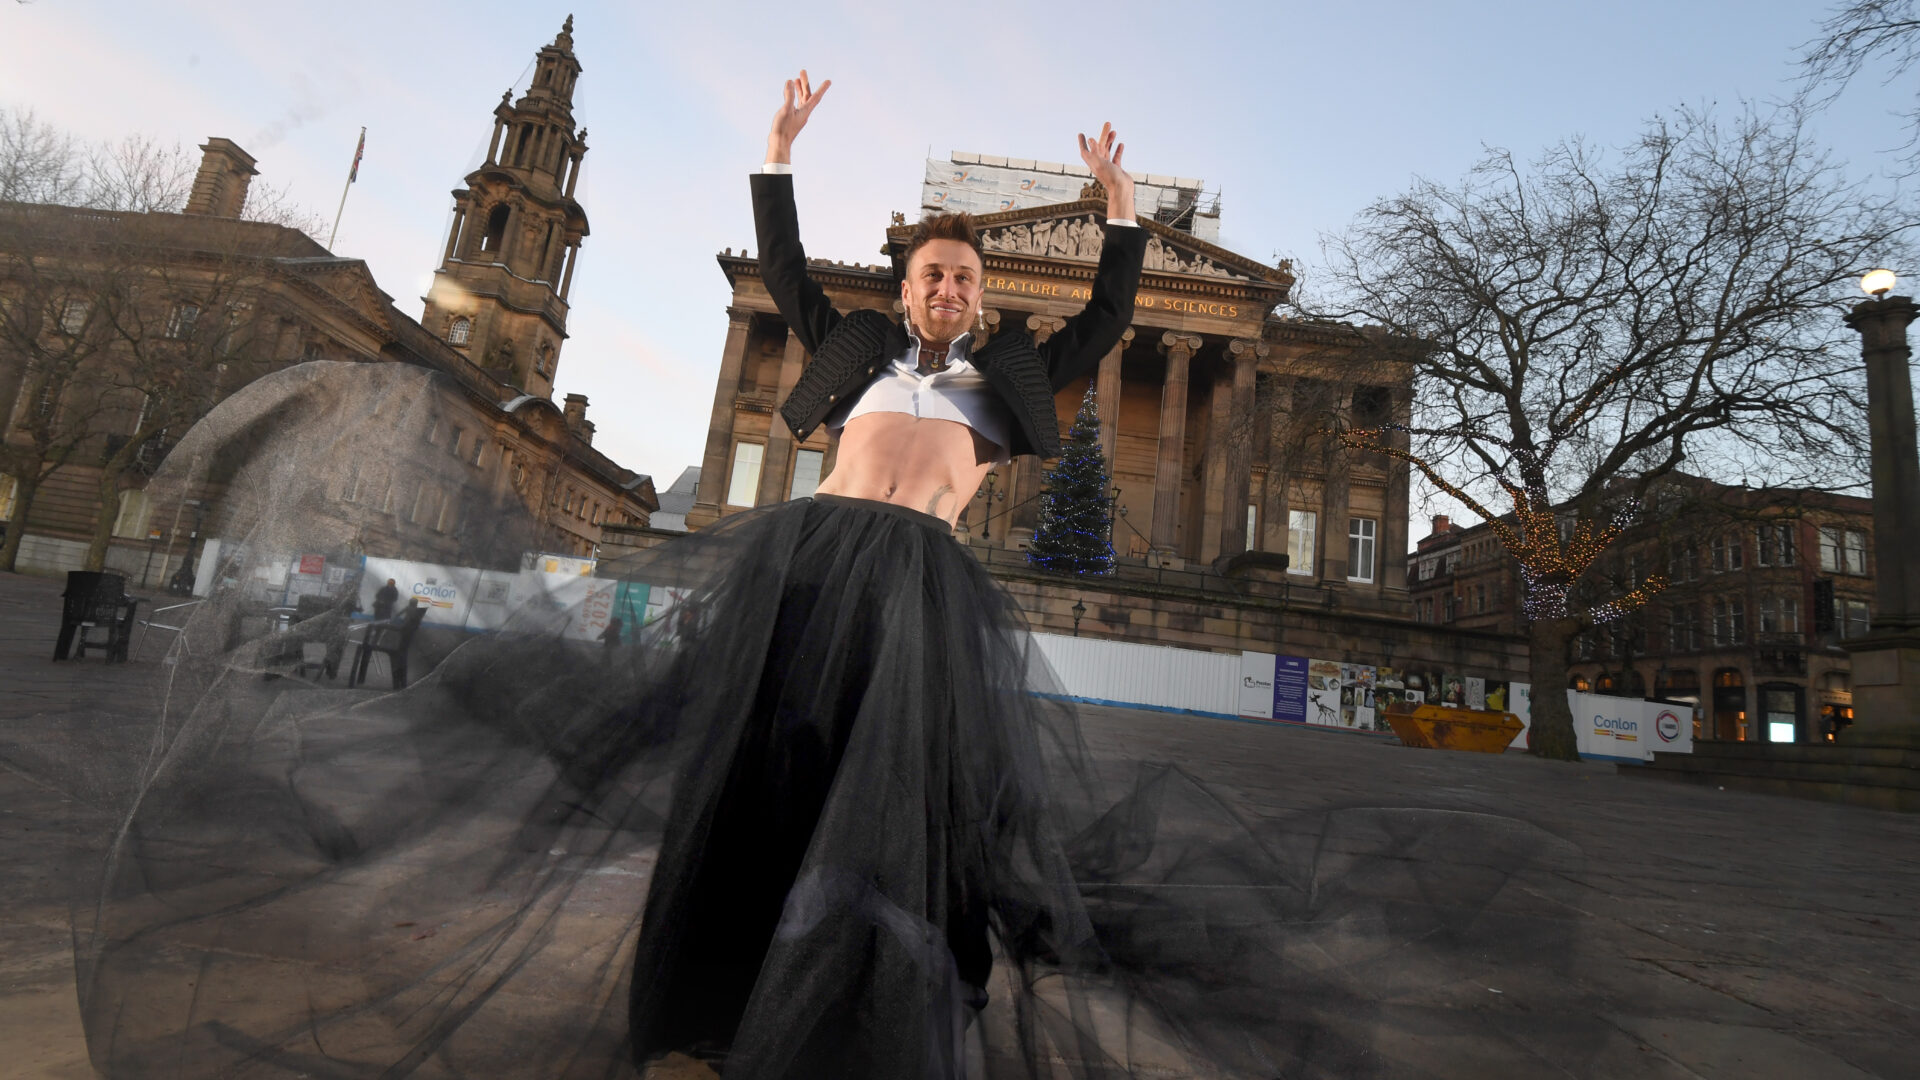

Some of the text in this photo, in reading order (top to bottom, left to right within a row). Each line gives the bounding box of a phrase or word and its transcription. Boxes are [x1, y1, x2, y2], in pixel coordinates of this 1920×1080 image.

[985, 277, 1238, 317] ERATURE AR ND SCIENCES
[412, 582, 457, 599] Conlon
[589, 591, 611, 629] 2025
[1593, 714, 1638, 731] Conlon
